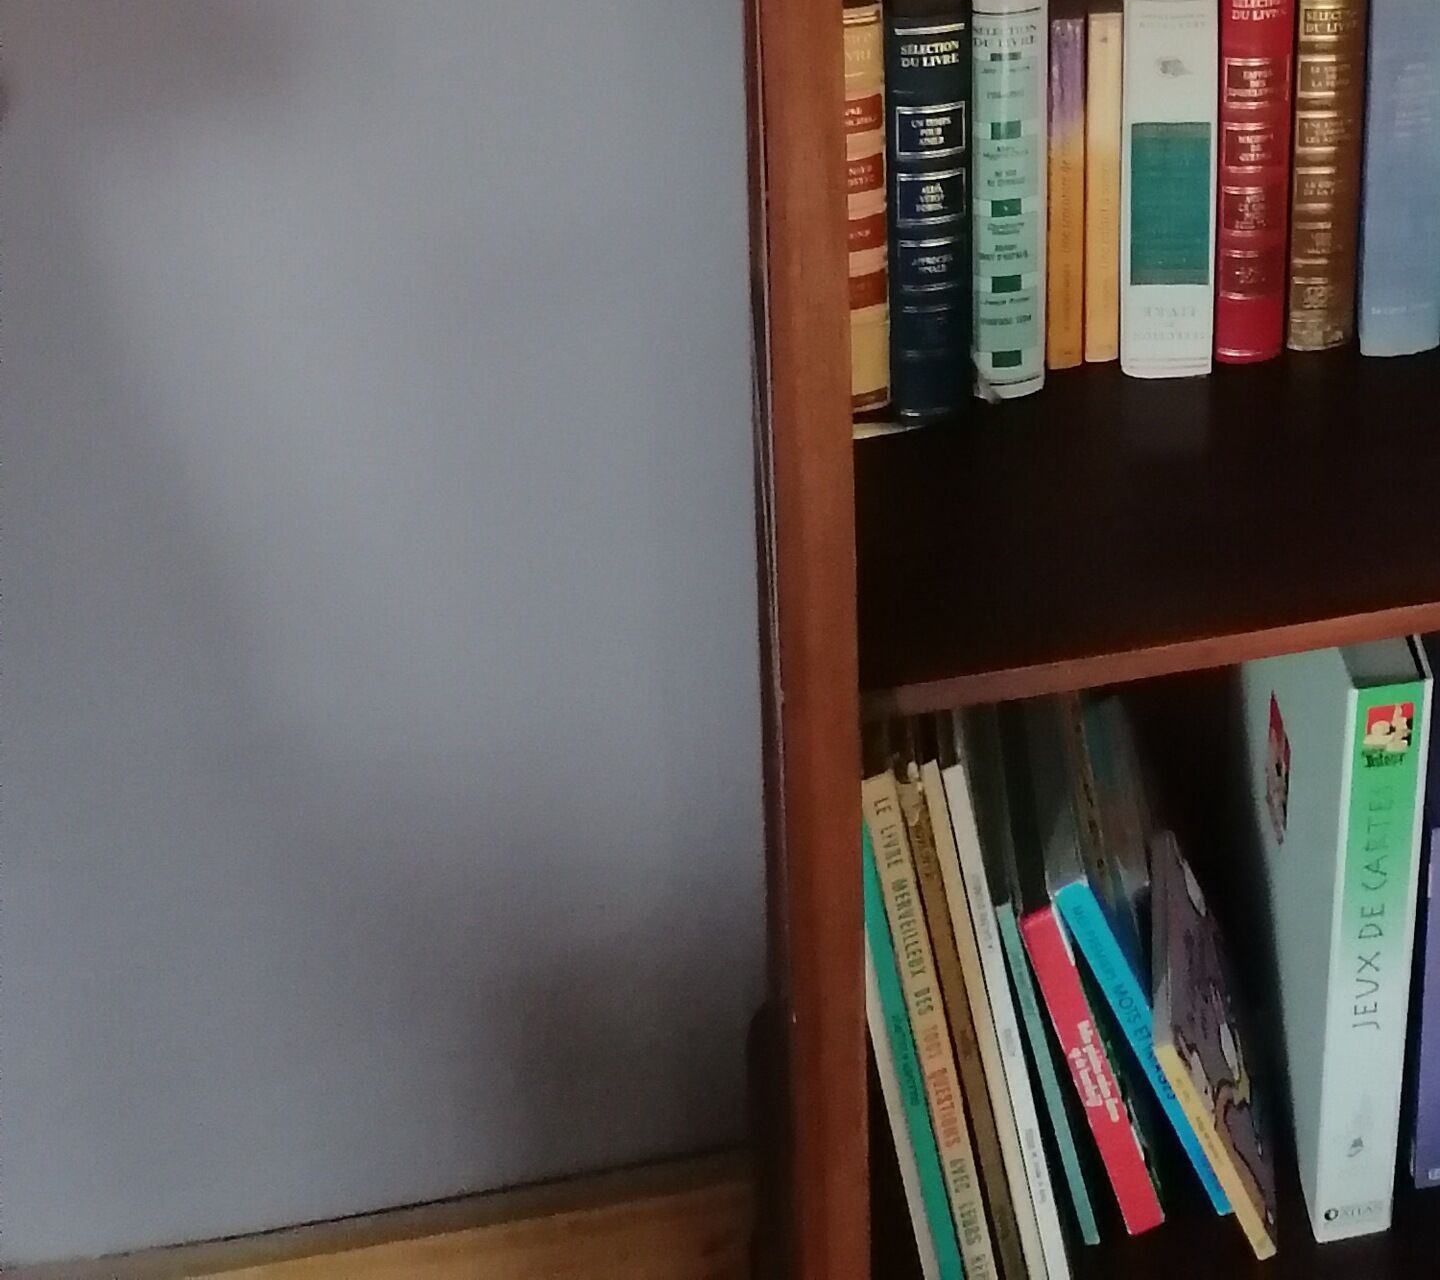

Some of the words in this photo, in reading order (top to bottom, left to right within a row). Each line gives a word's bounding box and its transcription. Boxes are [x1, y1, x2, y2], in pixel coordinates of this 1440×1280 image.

[1232, 10, 1250, 21] DU
[901, 57, 919, 68] DU
[922, 52, 960, 68] LIVRE
[873, 797, 892, 817] LE
[880, 824, 904, 869] LIVRE
[891, 878, 928, 979] MERVEILLEUX
[1358, 903, 1386, 940] DE
[1113, 981, 1143, 1024] MOTS
[1352, 951, 1382, 1031] JEUX
[927, 1067, 962, 1149] QUESTIONS
